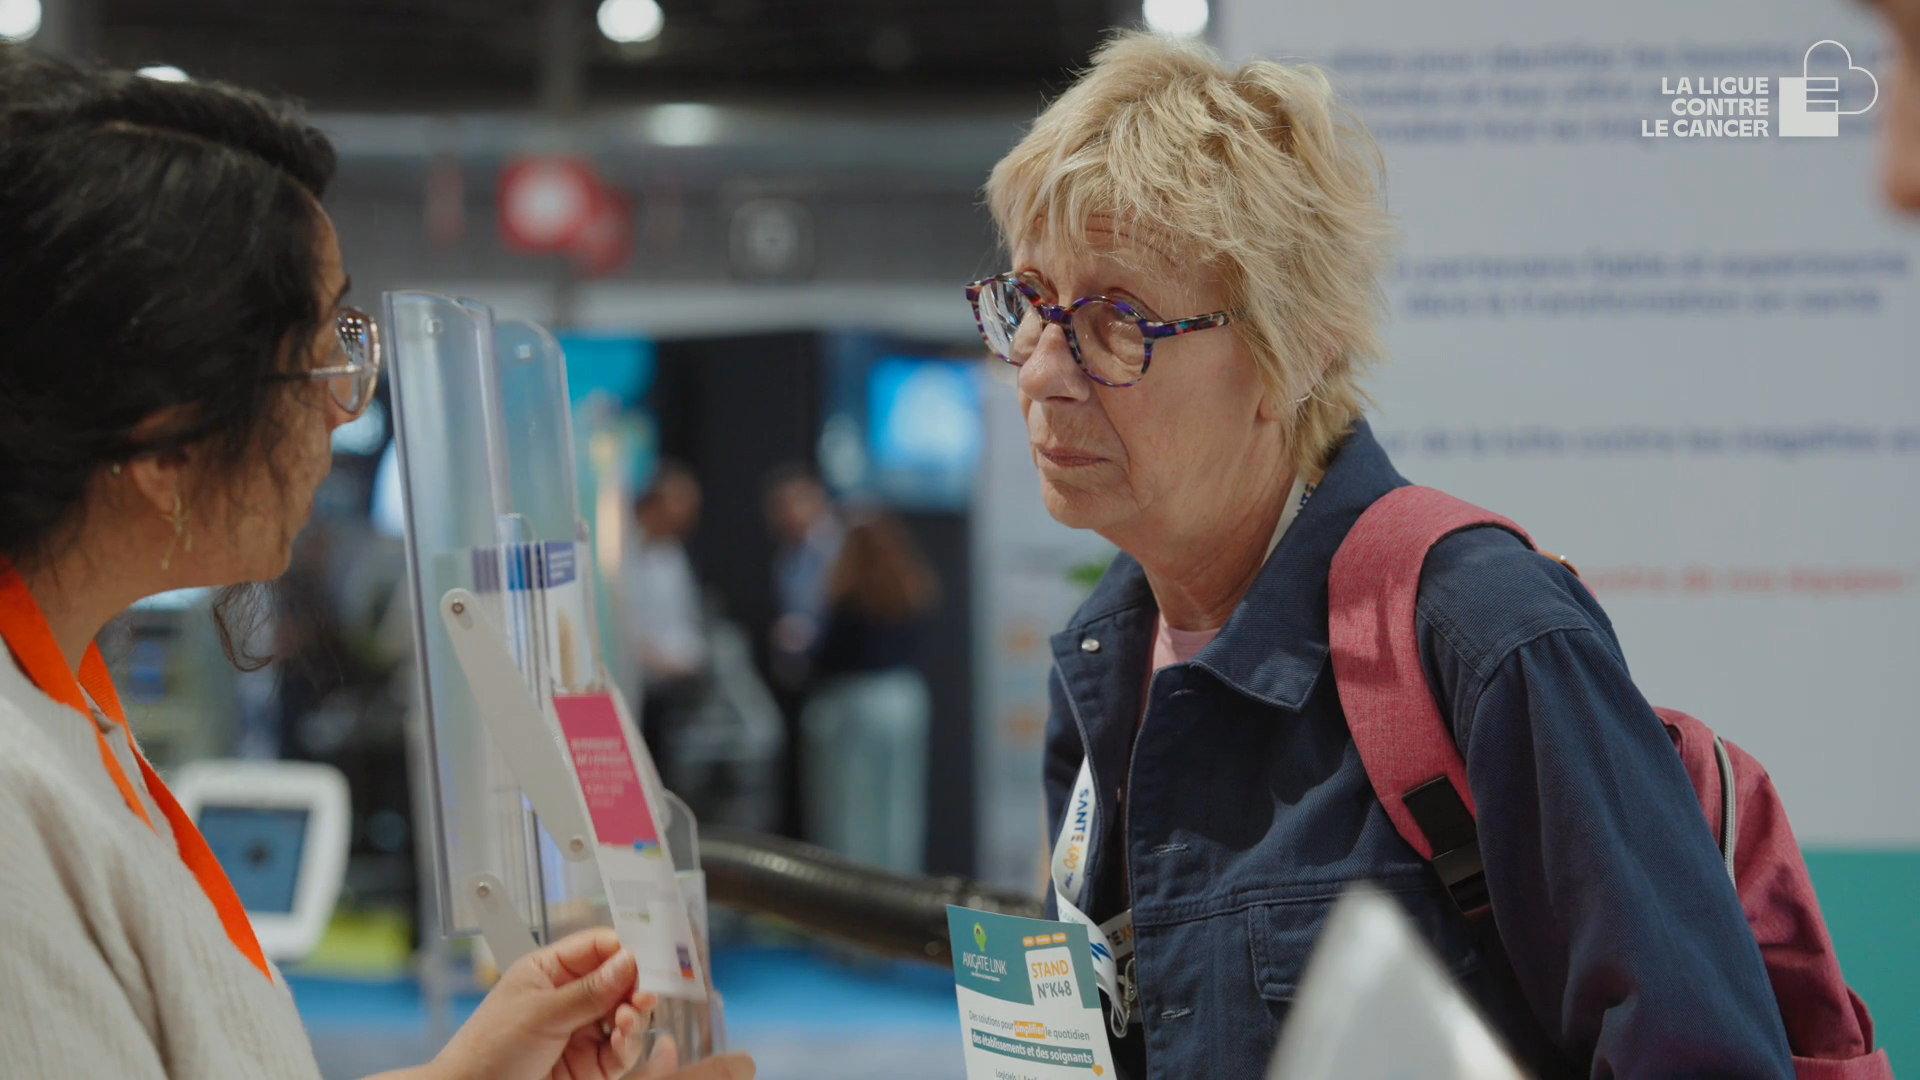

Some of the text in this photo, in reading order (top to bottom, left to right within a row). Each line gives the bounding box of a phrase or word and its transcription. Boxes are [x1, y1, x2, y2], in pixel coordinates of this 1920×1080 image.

[962, 951, 1007, 976] AXIGATE LINK
[1031, 959, 1070, 979] STAND
[1037, 980, 1072, 999] N°K48
[968, 1010, 1091, 1041] Des solutions pour simplifier le quotidien
[972, 1032, 1093, 1065] des établissements et des soignants
